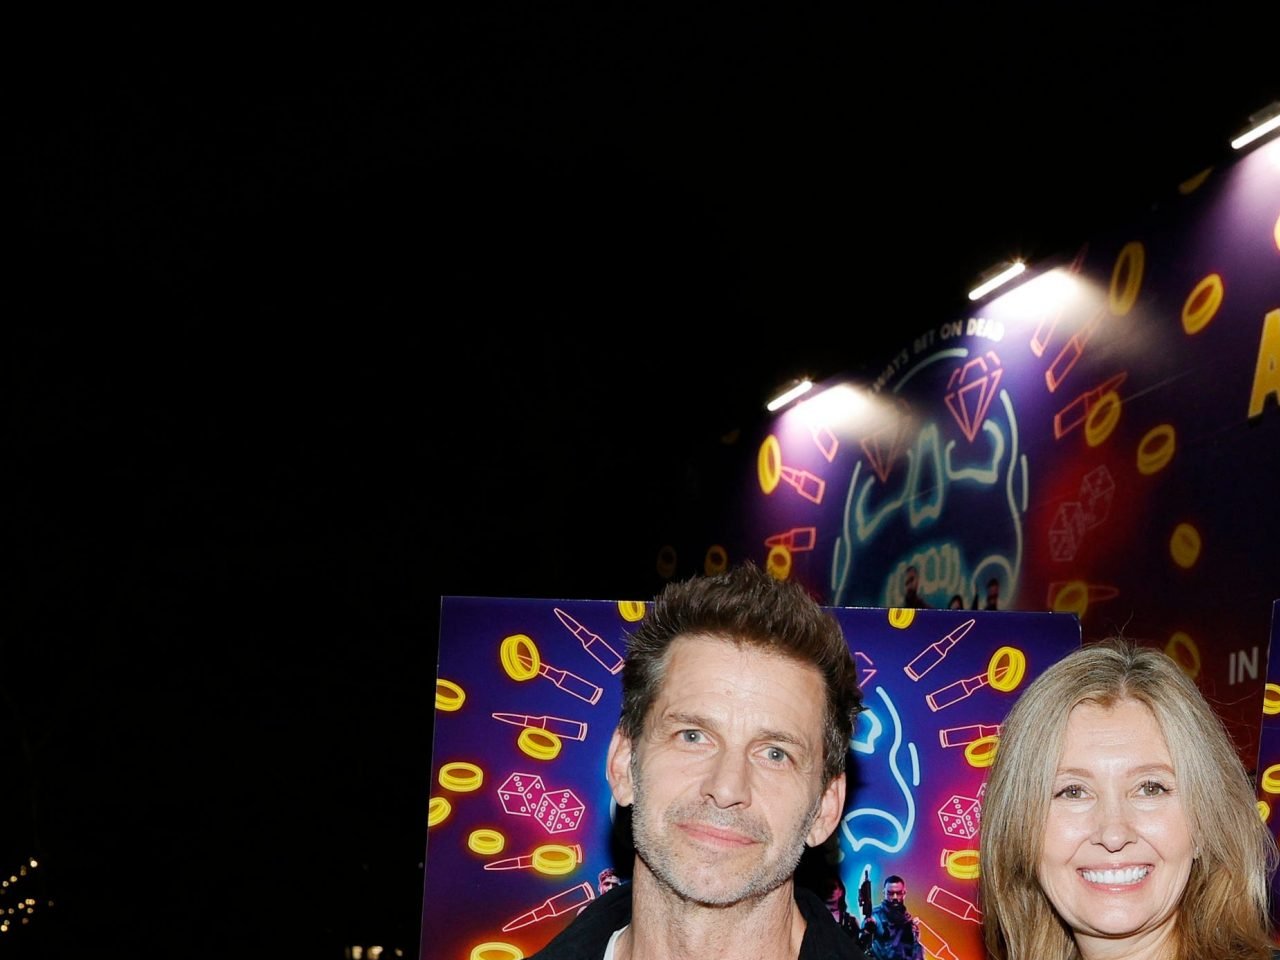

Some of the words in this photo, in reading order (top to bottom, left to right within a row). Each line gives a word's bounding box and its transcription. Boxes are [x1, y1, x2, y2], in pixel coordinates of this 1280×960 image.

[940, 320, 962, 340] ON
[966, 317, 1004, 342] DEAD
[1229, 646, 1258, 685] IN
